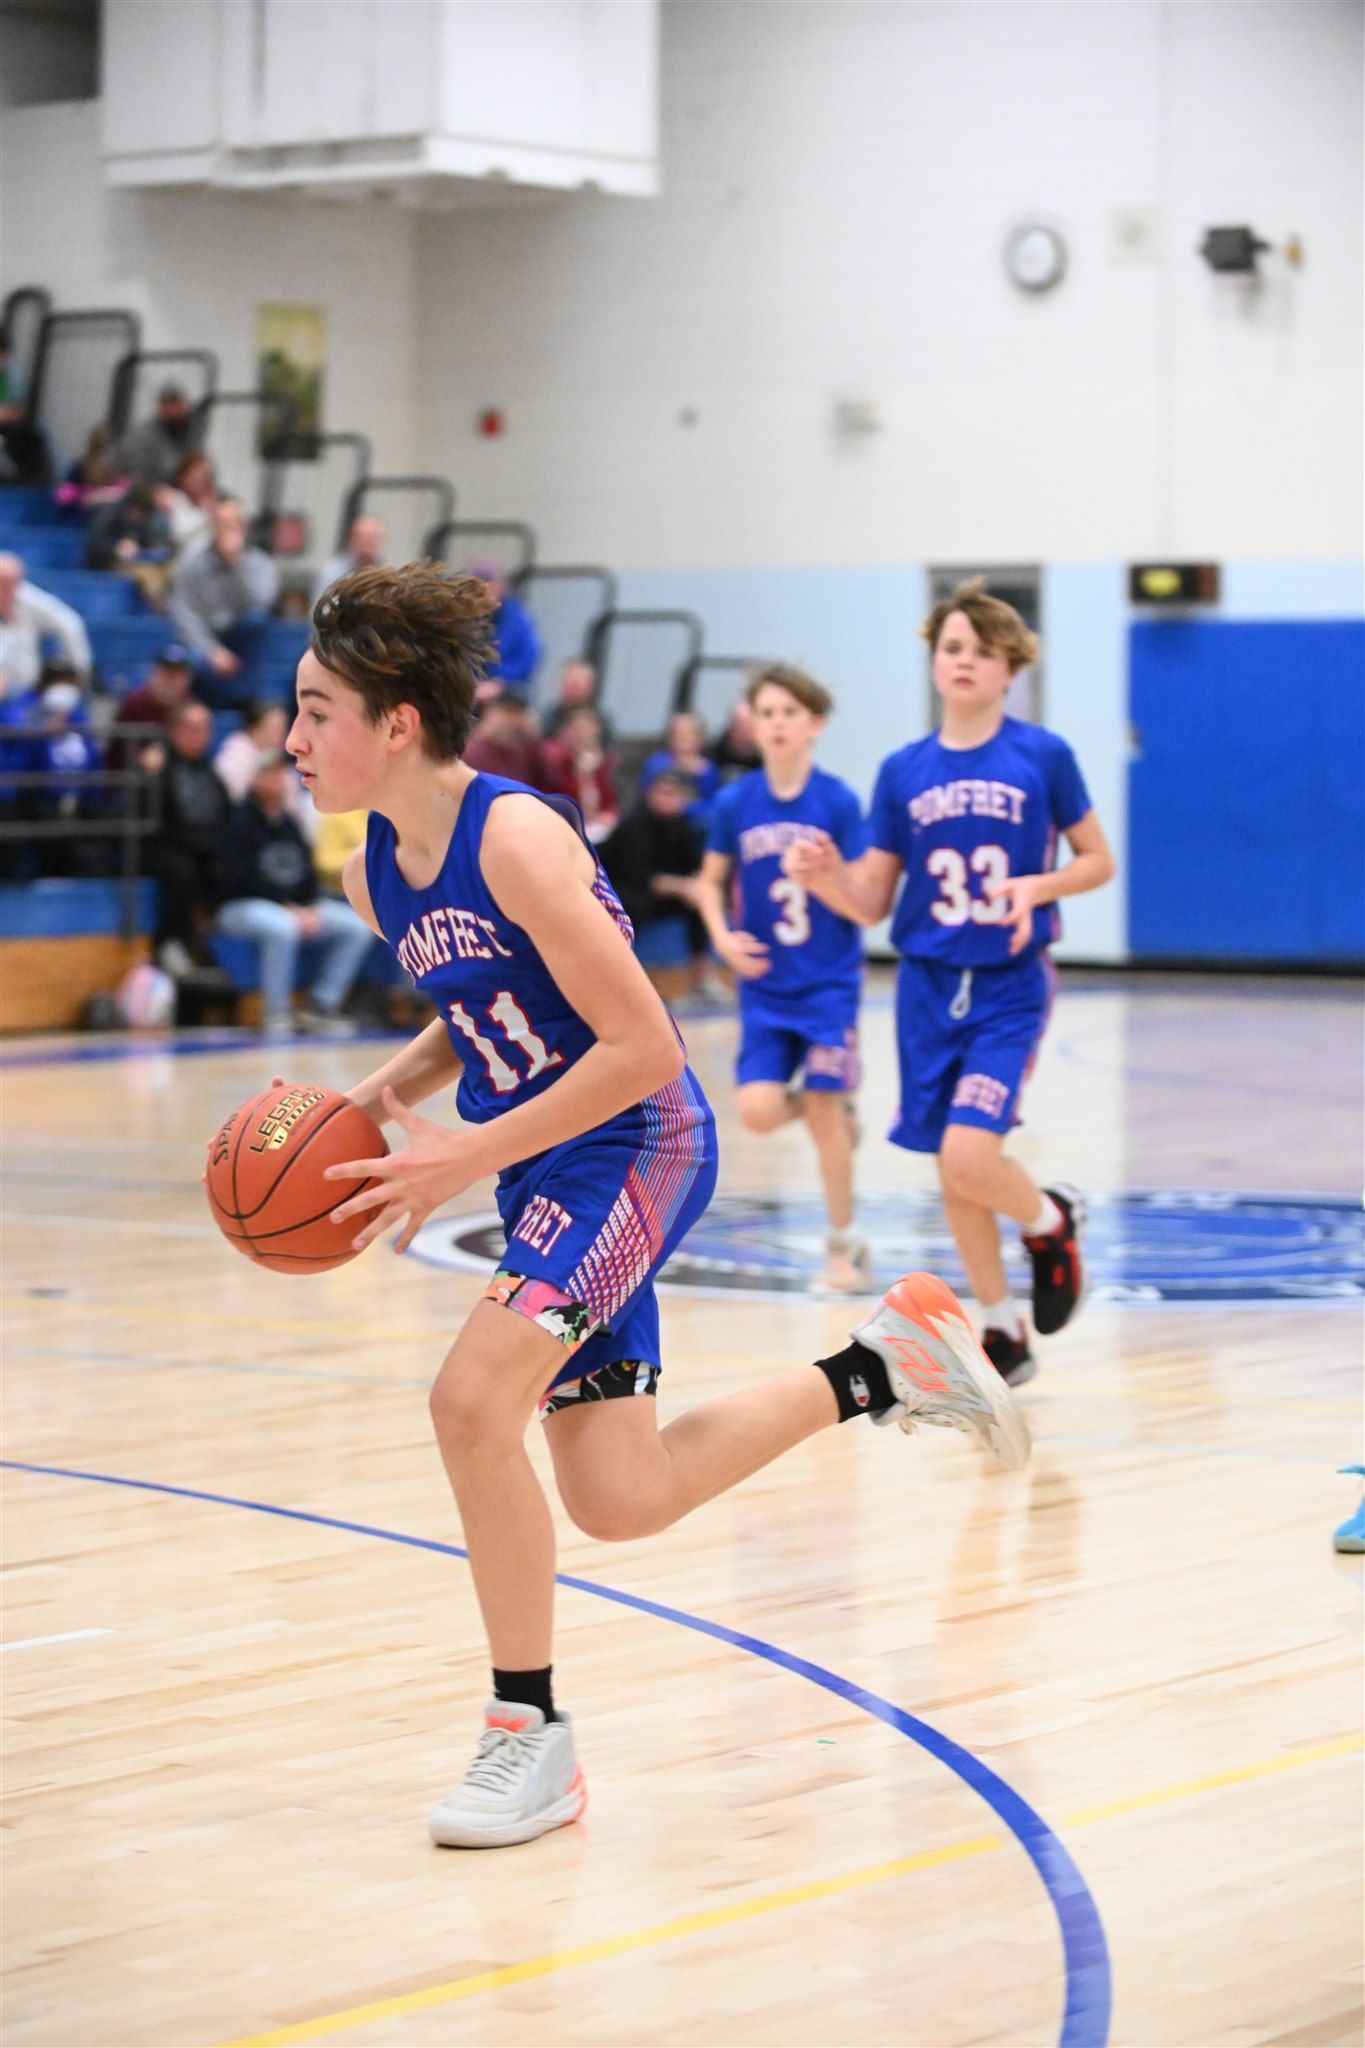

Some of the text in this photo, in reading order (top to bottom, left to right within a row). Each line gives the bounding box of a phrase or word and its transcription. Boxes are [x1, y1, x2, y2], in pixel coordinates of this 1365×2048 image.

[768, 877, 811, 946] 3
[926, 844, 1009, 926] 33
[449, 990, 565, 1094] 11
[511, 1194, 573, 1257] FRET
